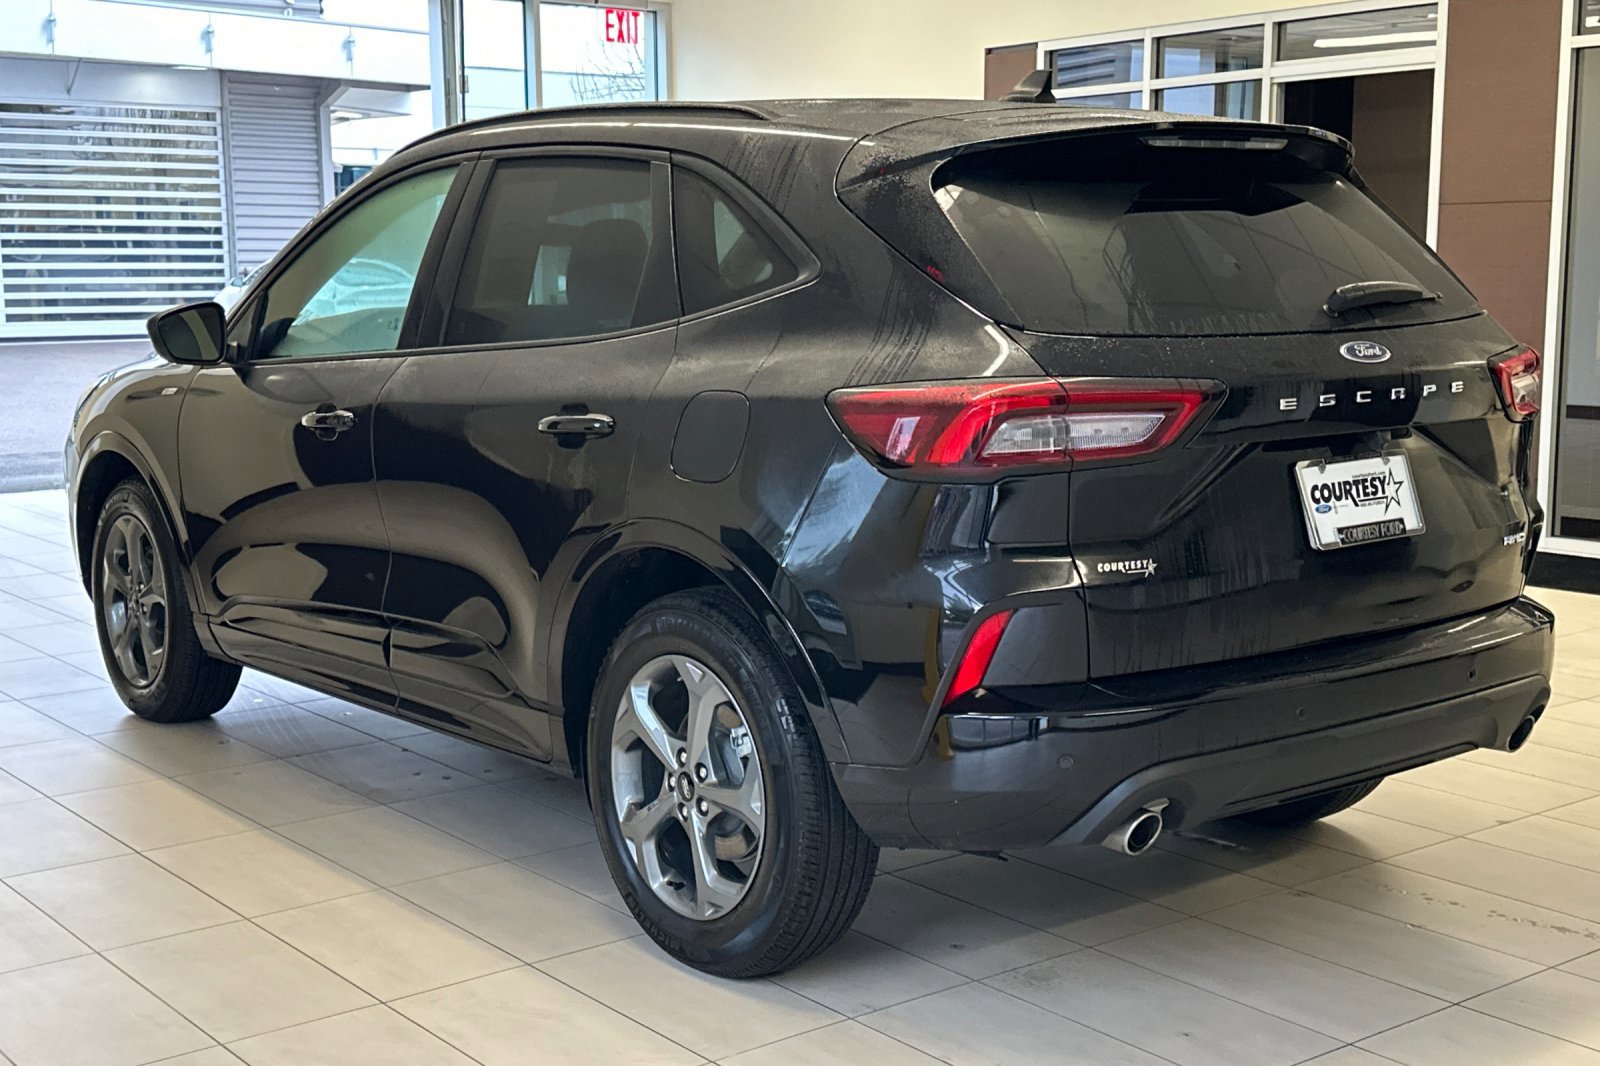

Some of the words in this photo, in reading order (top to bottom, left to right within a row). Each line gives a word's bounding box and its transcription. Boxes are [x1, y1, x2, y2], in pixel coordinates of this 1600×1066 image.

[606, 8, 640, 44] EXIT
[1280, 381, 1464, 411] ESCAPE
[1310, 475, 1387, 507] COURTESY
[1343, 526, 1380, 542] COURTESY
[1381, 522, 1401, 536] FORD
[1097, 560, 1148, 574] COURTESY
